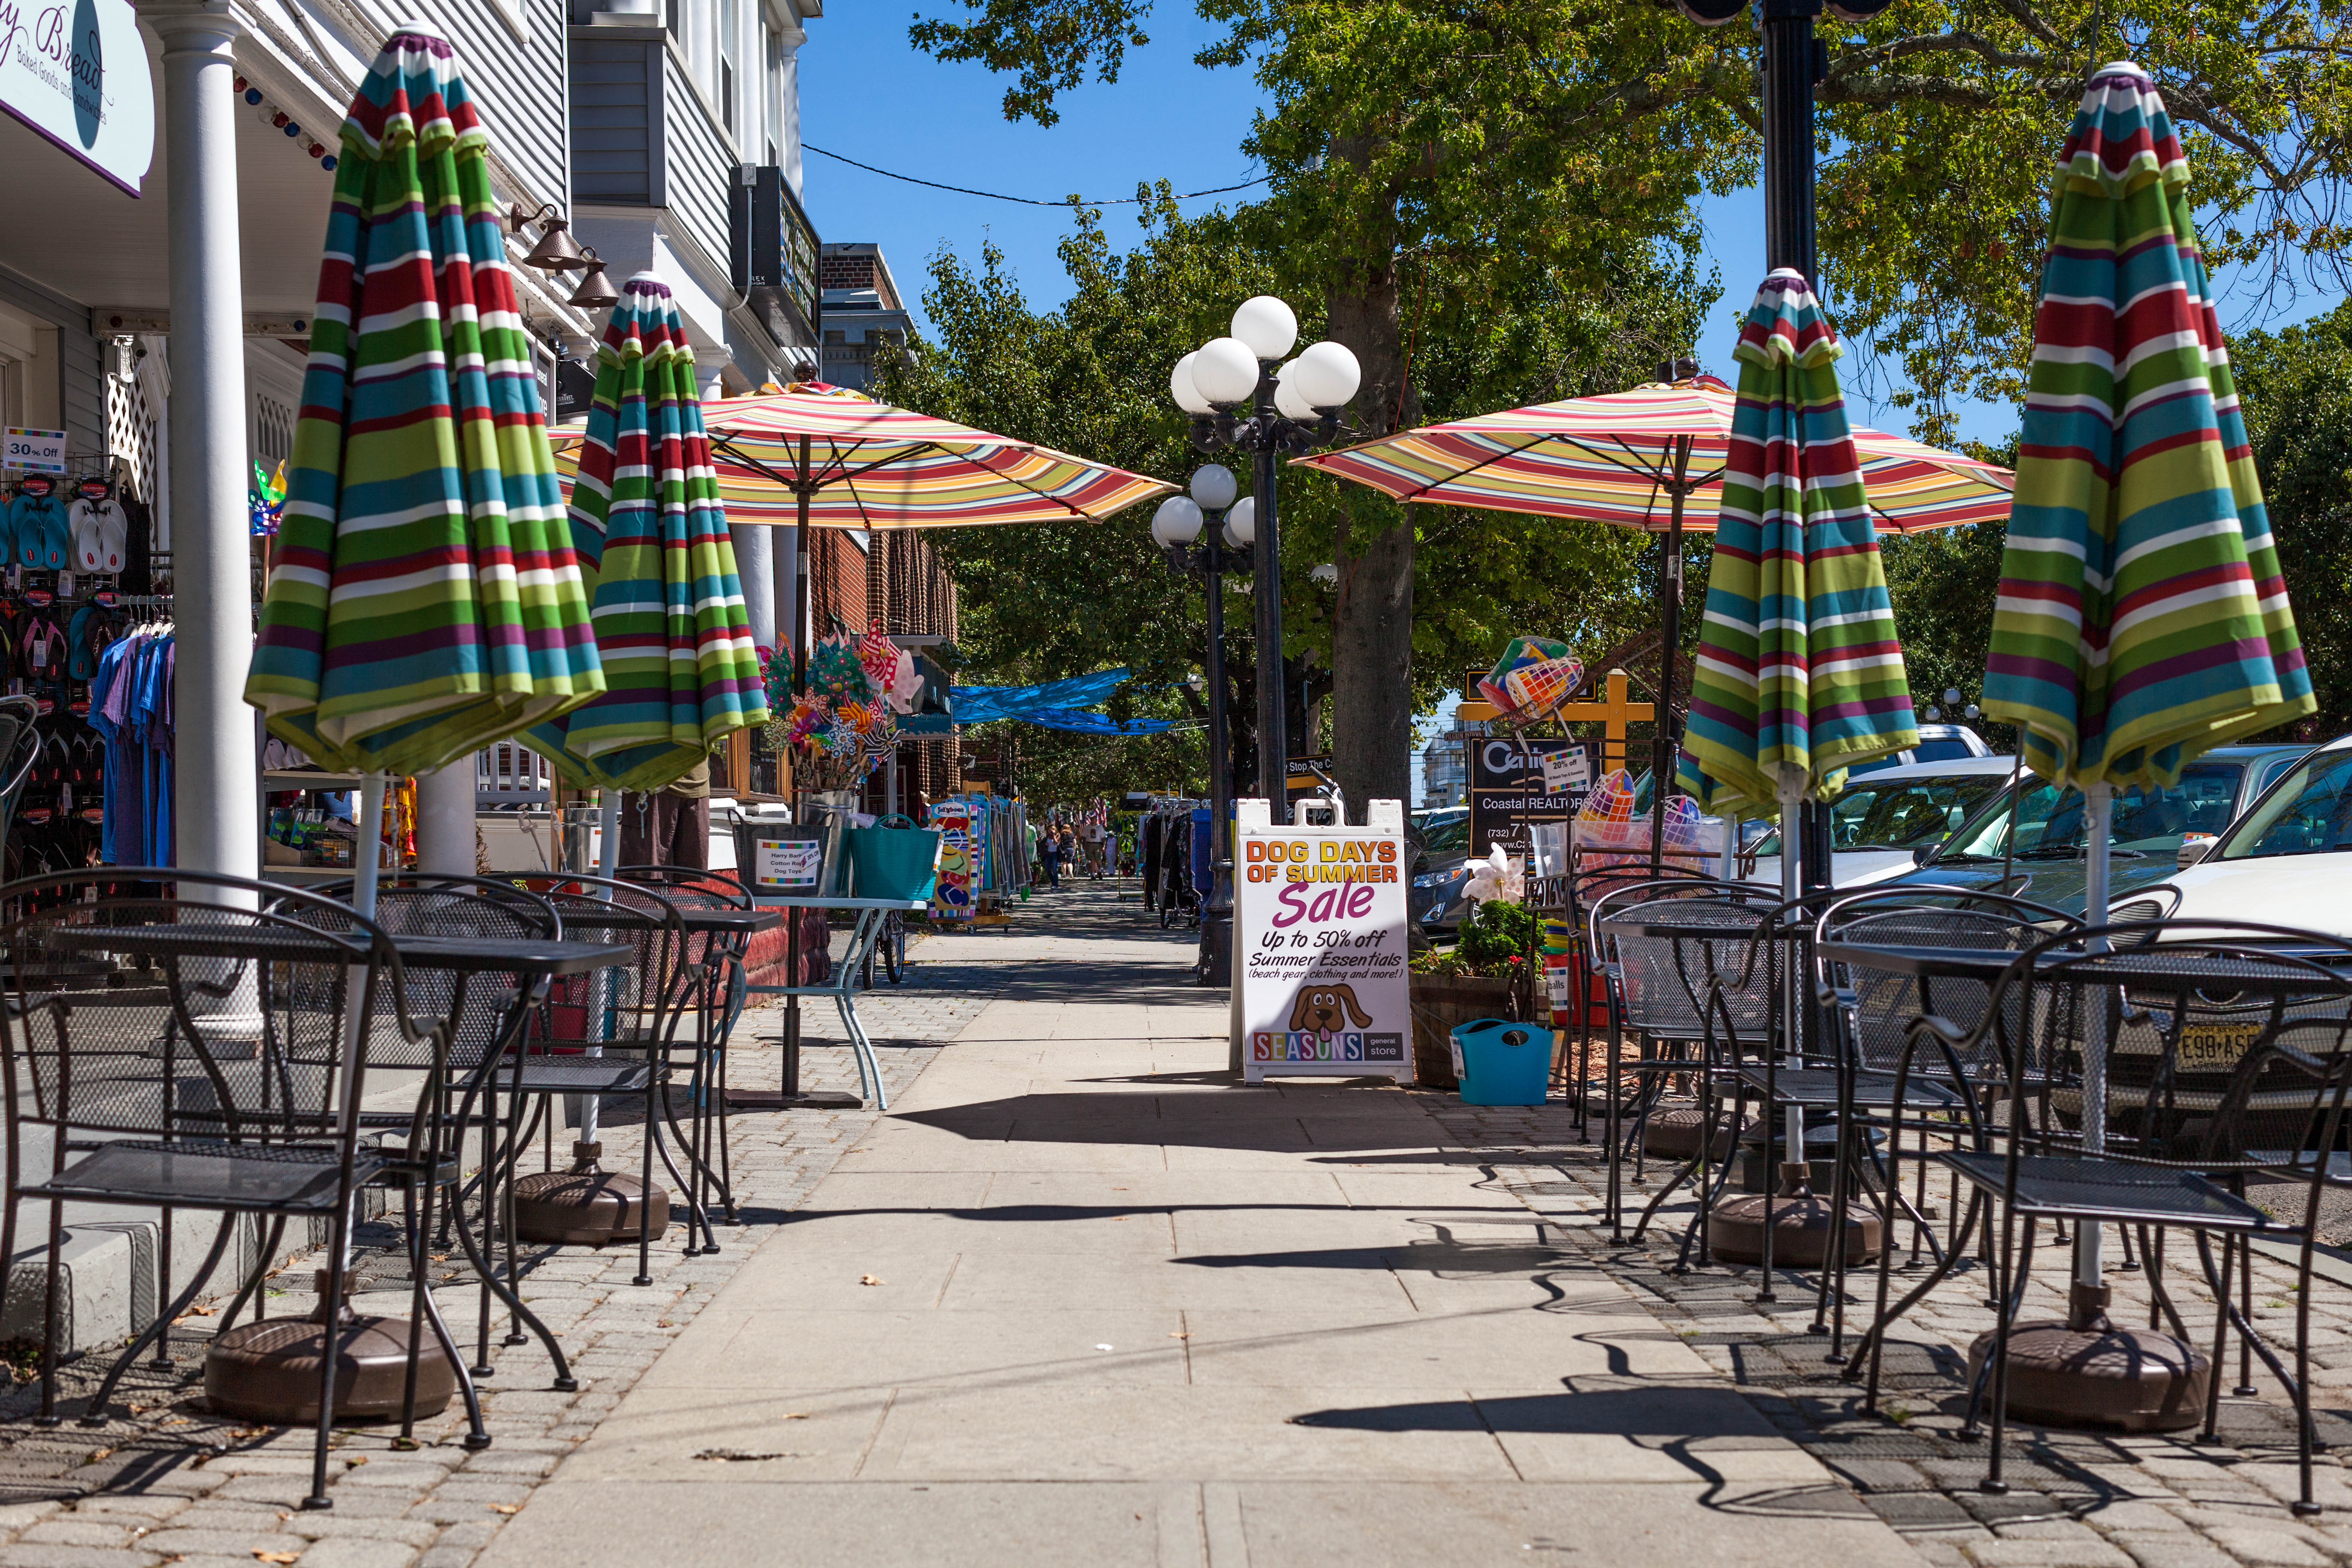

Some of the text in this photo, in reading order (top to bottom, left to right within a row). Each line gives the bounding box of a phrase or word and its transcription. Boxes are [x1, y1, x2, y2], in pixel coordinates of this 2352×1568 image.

[37, 6, 106, 90] Bread
[18, 44, 106, 125] Baked Goods and Sandwiches
[537, 368, 548, 386] eneral
[10, 443, 58, 458] 30% Off
[1445, 732, 1464, 740] PILGRIM
[1290, 762, 1307, 773] Stop
[1308, 760, 1323, 769] The
[1553, 760, 1568, 769] 20%
[1483, 798, 1524, 809] Coastal
[1488, 829, 1509, 838] (732)
[1247, 841, 1397, 863] DOG DAYS
[1248, 865, 1398, 883] OF SUMMER
[1272, 876, 1375, 928] Sale
[1262, 929, 1387, 952] Up to 50% off
[1249, 951, 1402, 967] Summer Essentials
[1249, 968, 1403, 981] (beach gear, clothing and more!)
[1257, 1034, 1360, 1060] SEASONS
[1371, 1046, 1396, 1055] store
